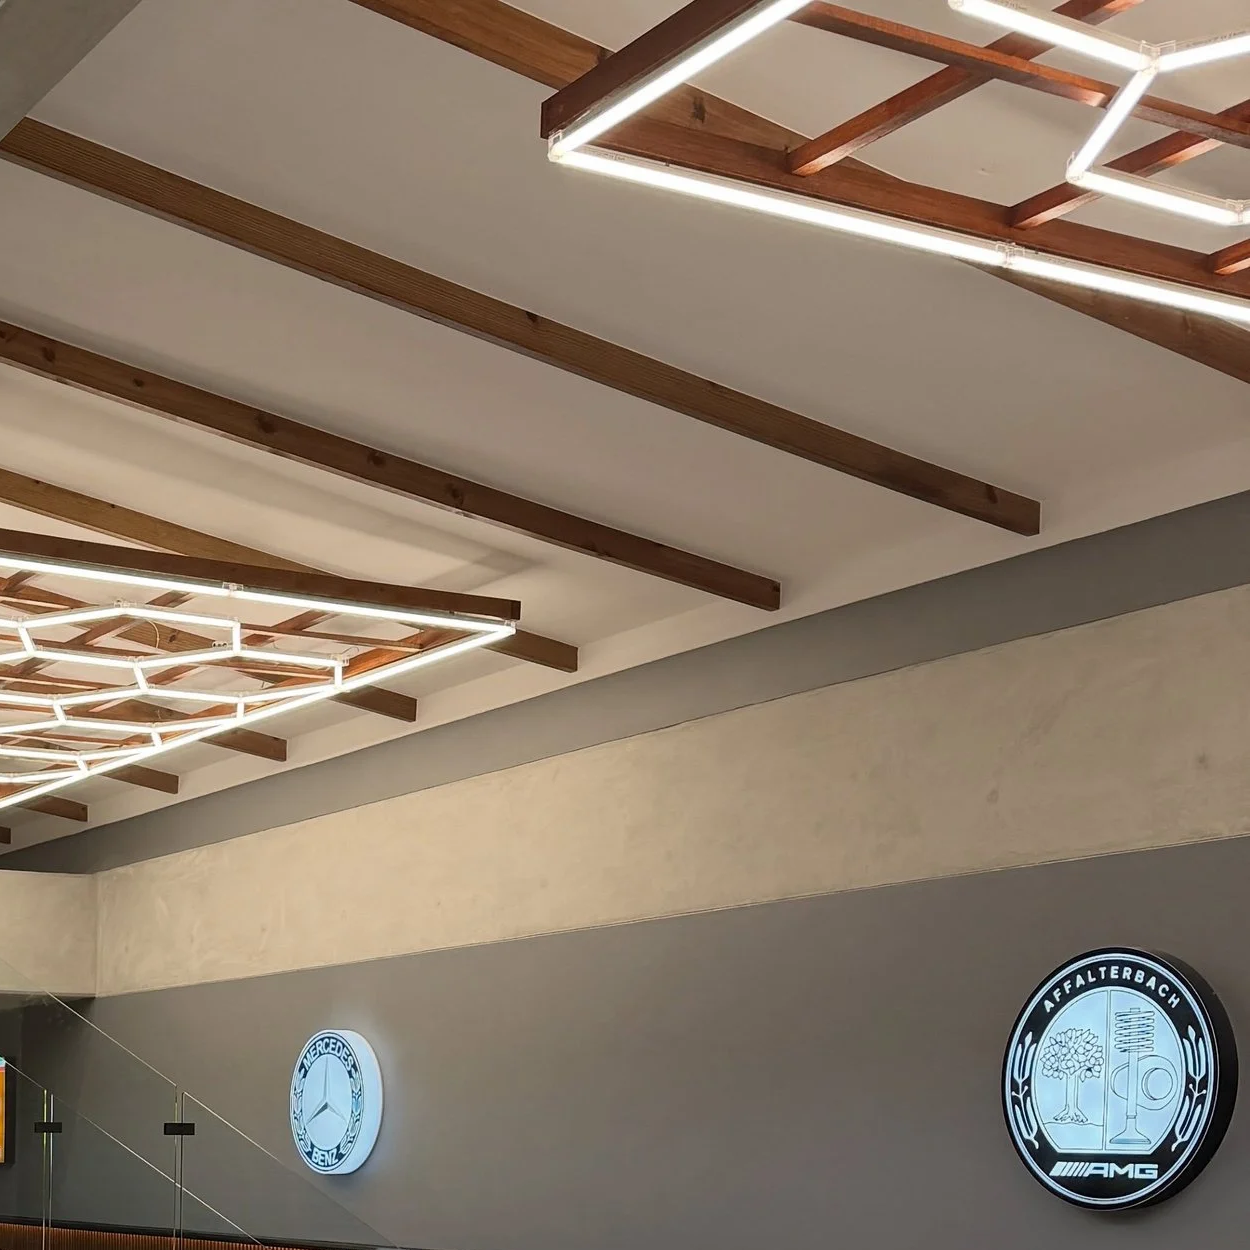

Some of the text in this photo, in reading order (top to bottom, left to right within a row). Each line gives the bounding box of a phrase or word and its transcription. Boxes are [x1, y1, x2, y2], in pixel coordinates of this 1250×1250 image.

[1043, 965, 1181, 1013] AFFALTERBACH
[303, 1037, 354, 1071] MERCEDES
[311, 1148, 339, 1167] BENZ
[1084, 1161, 1159, 1180] AMG
